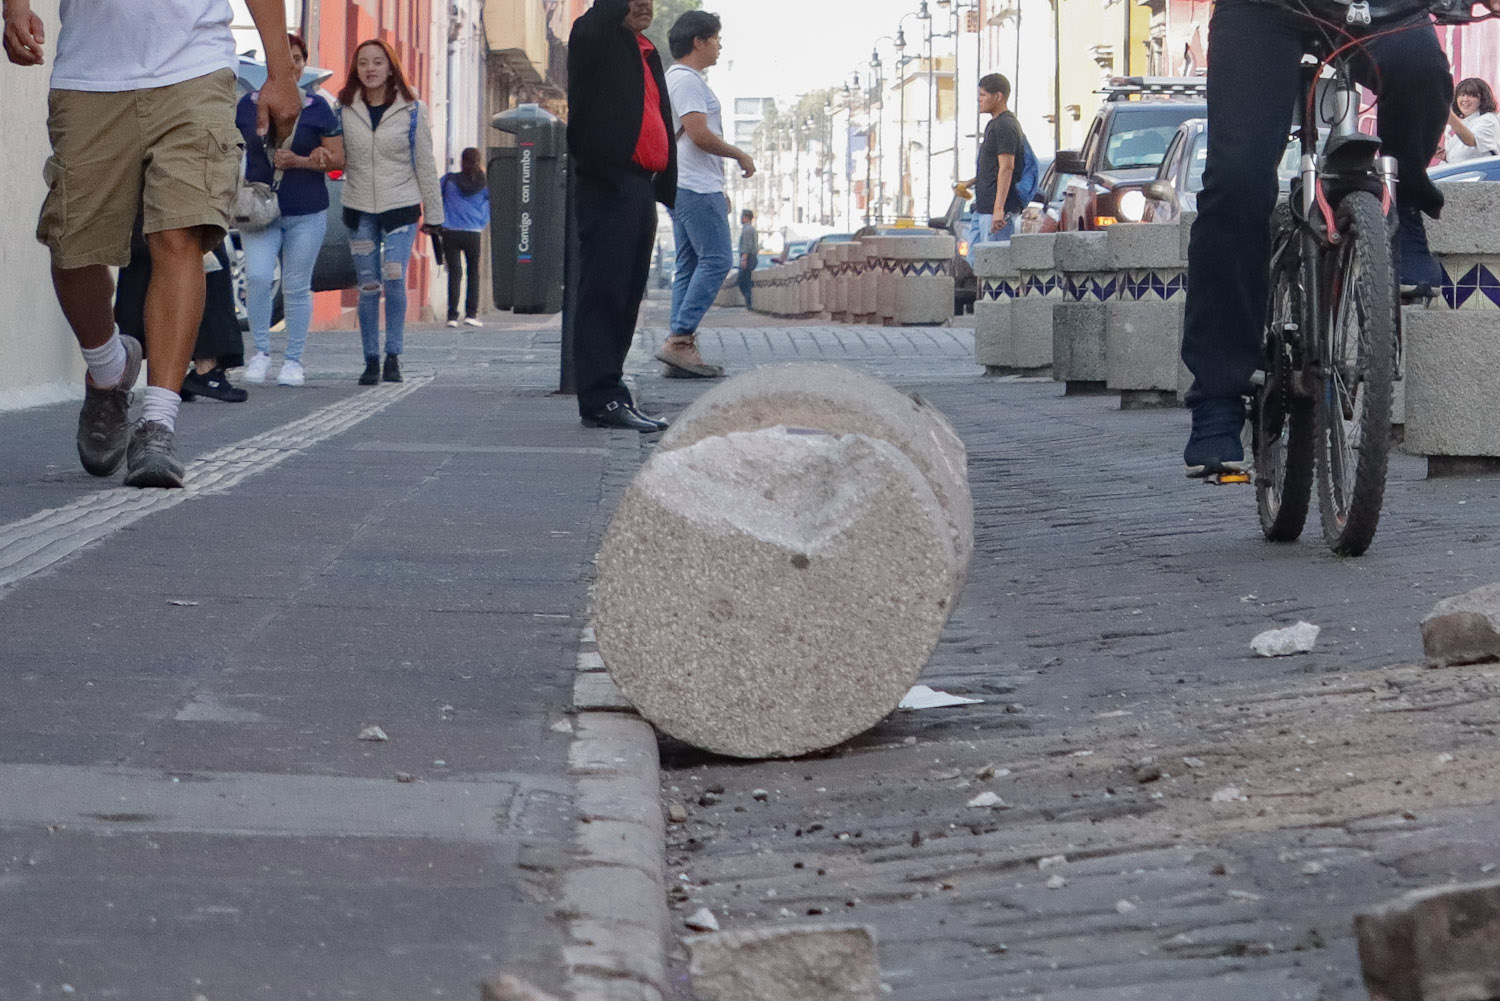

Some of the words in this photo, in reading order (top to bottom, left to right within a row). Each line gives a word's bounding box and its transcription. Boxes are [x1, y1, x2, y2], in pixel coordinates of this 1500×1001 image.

[520, 149, 532, 183] rumbo
[521, 184, 531, 203] con
[518, 212, 533, 252] Contigo
